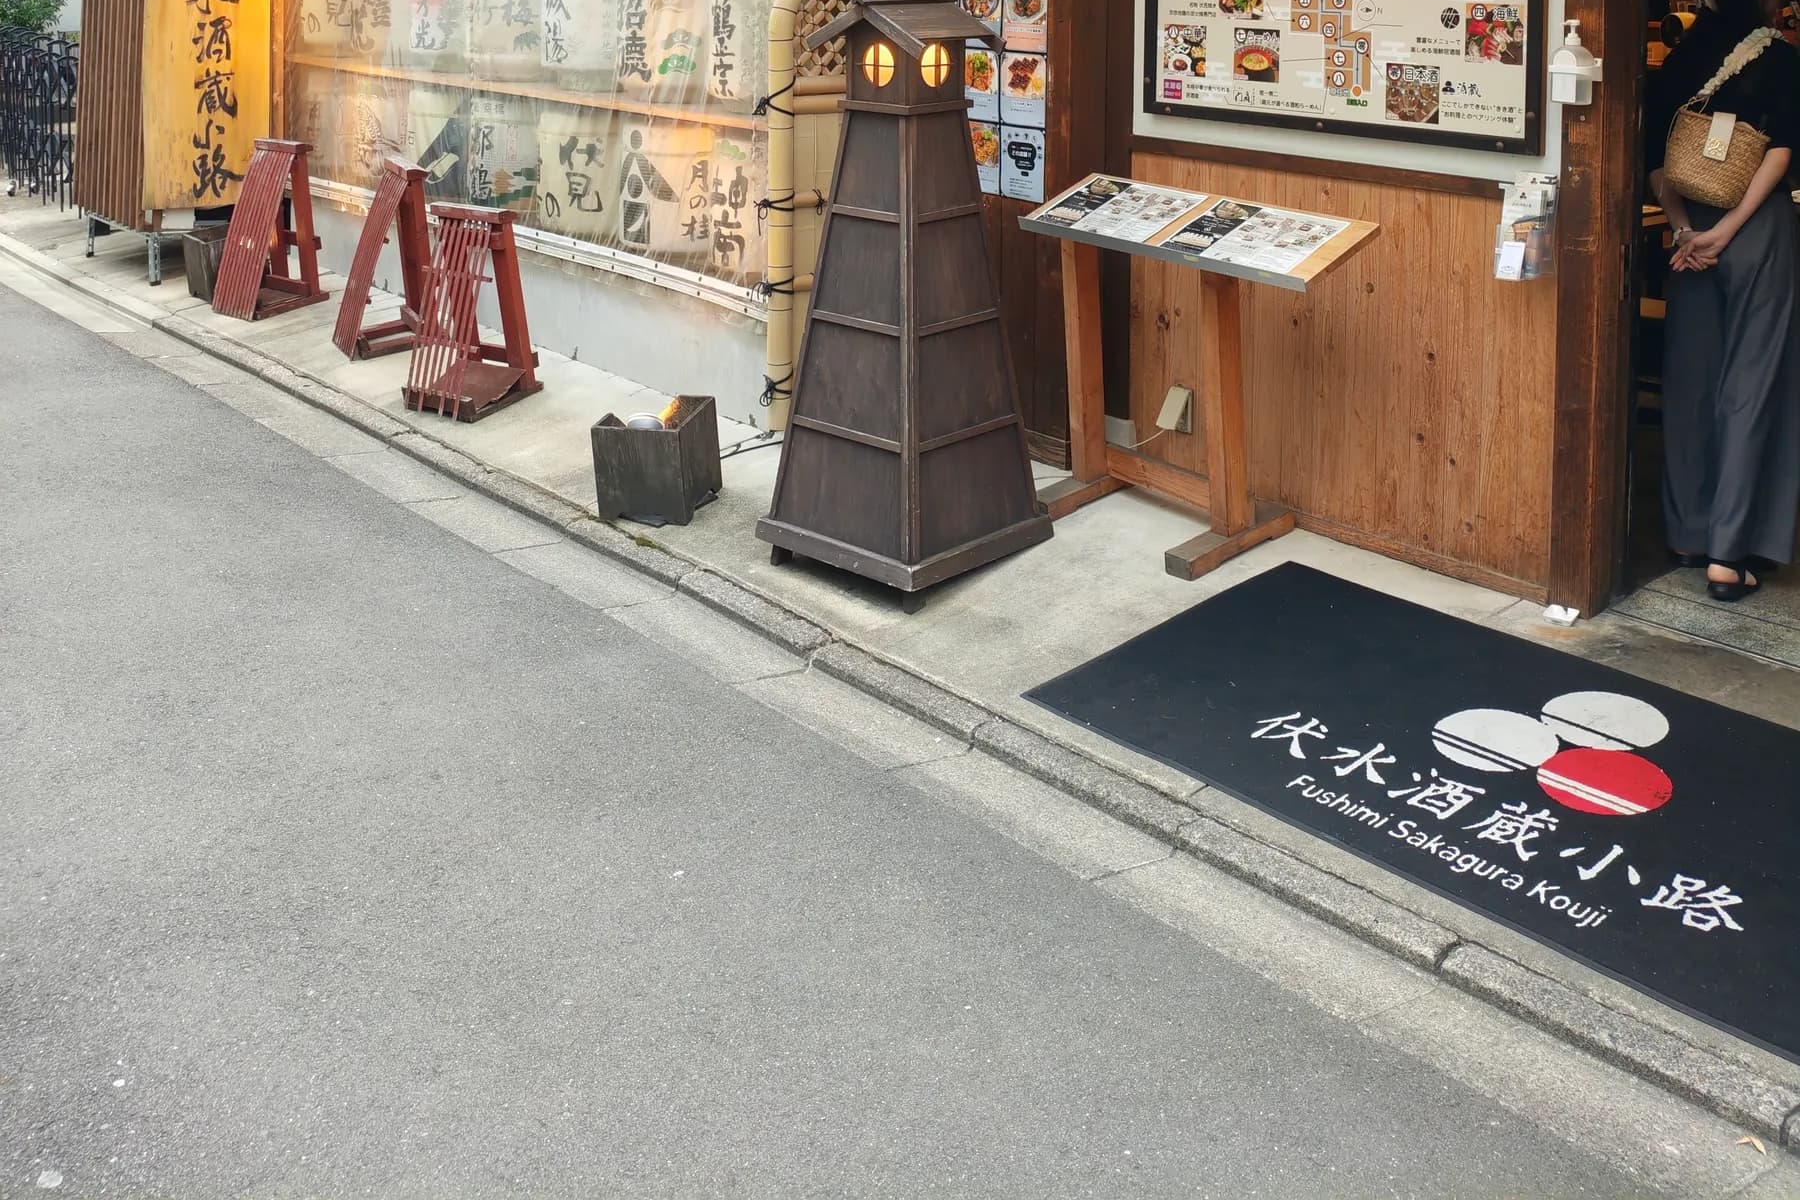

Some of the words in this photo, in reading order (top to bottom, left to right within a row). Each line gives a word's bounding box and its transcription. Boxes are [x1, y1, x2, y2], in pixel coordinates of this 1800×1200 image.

[1493, 7, 1520, 20] 海鮮
[1403, 67, 1439, 83] 日本酒
[681, 159, 712, 241] 月の桂
[1250, 711, 1744, 933] 伏水酒蔵小路
[1286, 774, 1389, 830] Fushimi
[1387, 818, 1525, 891] Sakagura
[1527, 878, 1613, 929] Kouji
